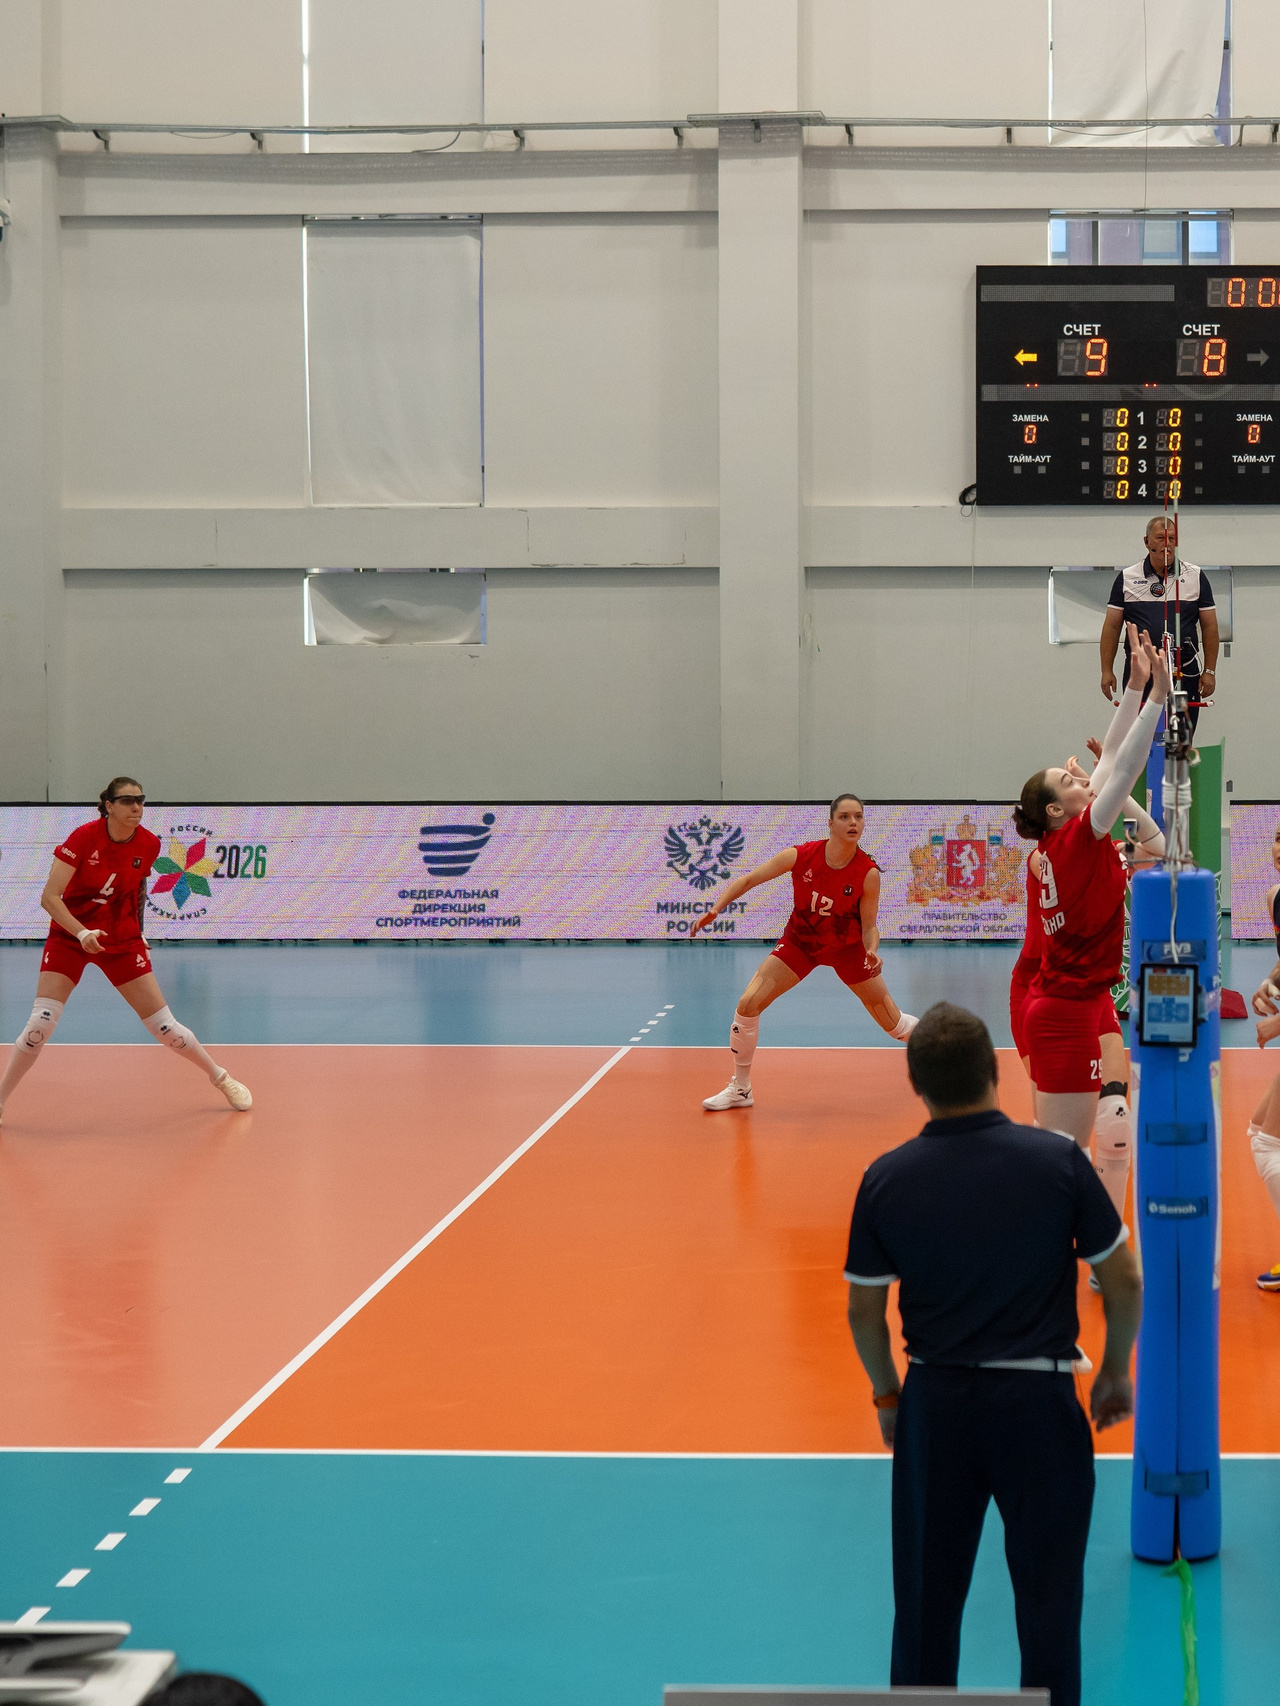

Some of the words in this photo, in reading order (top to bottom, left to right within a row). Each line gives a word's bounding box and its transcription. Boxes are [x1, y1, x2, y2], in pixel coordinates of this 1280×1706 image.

[1063, 324, 1101, 336] СЧЕТ
[1182, 324, 1220, 336] СЧЕТ
[1085, 338, 1108, 376] 9
[1203, 338, 1227, 376] 8
[1012, 413, 1049, 424] ЗАМЕНА
[1115, 408, 1129, 427] 0
[1137, 411, 1145, 425] 1
[1168, 408, 1182, 427] 0
[1236, 413, 1273, 423] ЗАМЕНА
[1024, 424, 1037, 444] 0
[1247, 424, 1260, 444] 0
[1115, 432, 1129, 451] 0
[1137, 435, 1147, 449] 2
[1168, 432, 1182, 451] 0
[1008, 454, 1051, 464] ТАЙМ-АУТ
[1232, 454, 1275, 464] ТАЙМ-АУТ
[1115, 456, 1129, 475] 0
[1137, 459, 1147, 473] 3
[1115, 480, 1129, 499] 0
[1137, 484, 1147, 497] 4
[212, 844, 268, 879] 2026
[398, 889, 499, 900] ФЕДЕРАЛЬНАЯ
[411, 903, 486, 914] ДИРЕКЦИЯ
[810, 890, 834, 917] 12
[375, 915, 521, 927] СПОРТМЕРОПРИЯТИЙ
[923, 912, 1008, 921] ПРАВИТЕЛЬСТВО
[667, 921, 735, 933] РОСИИ
